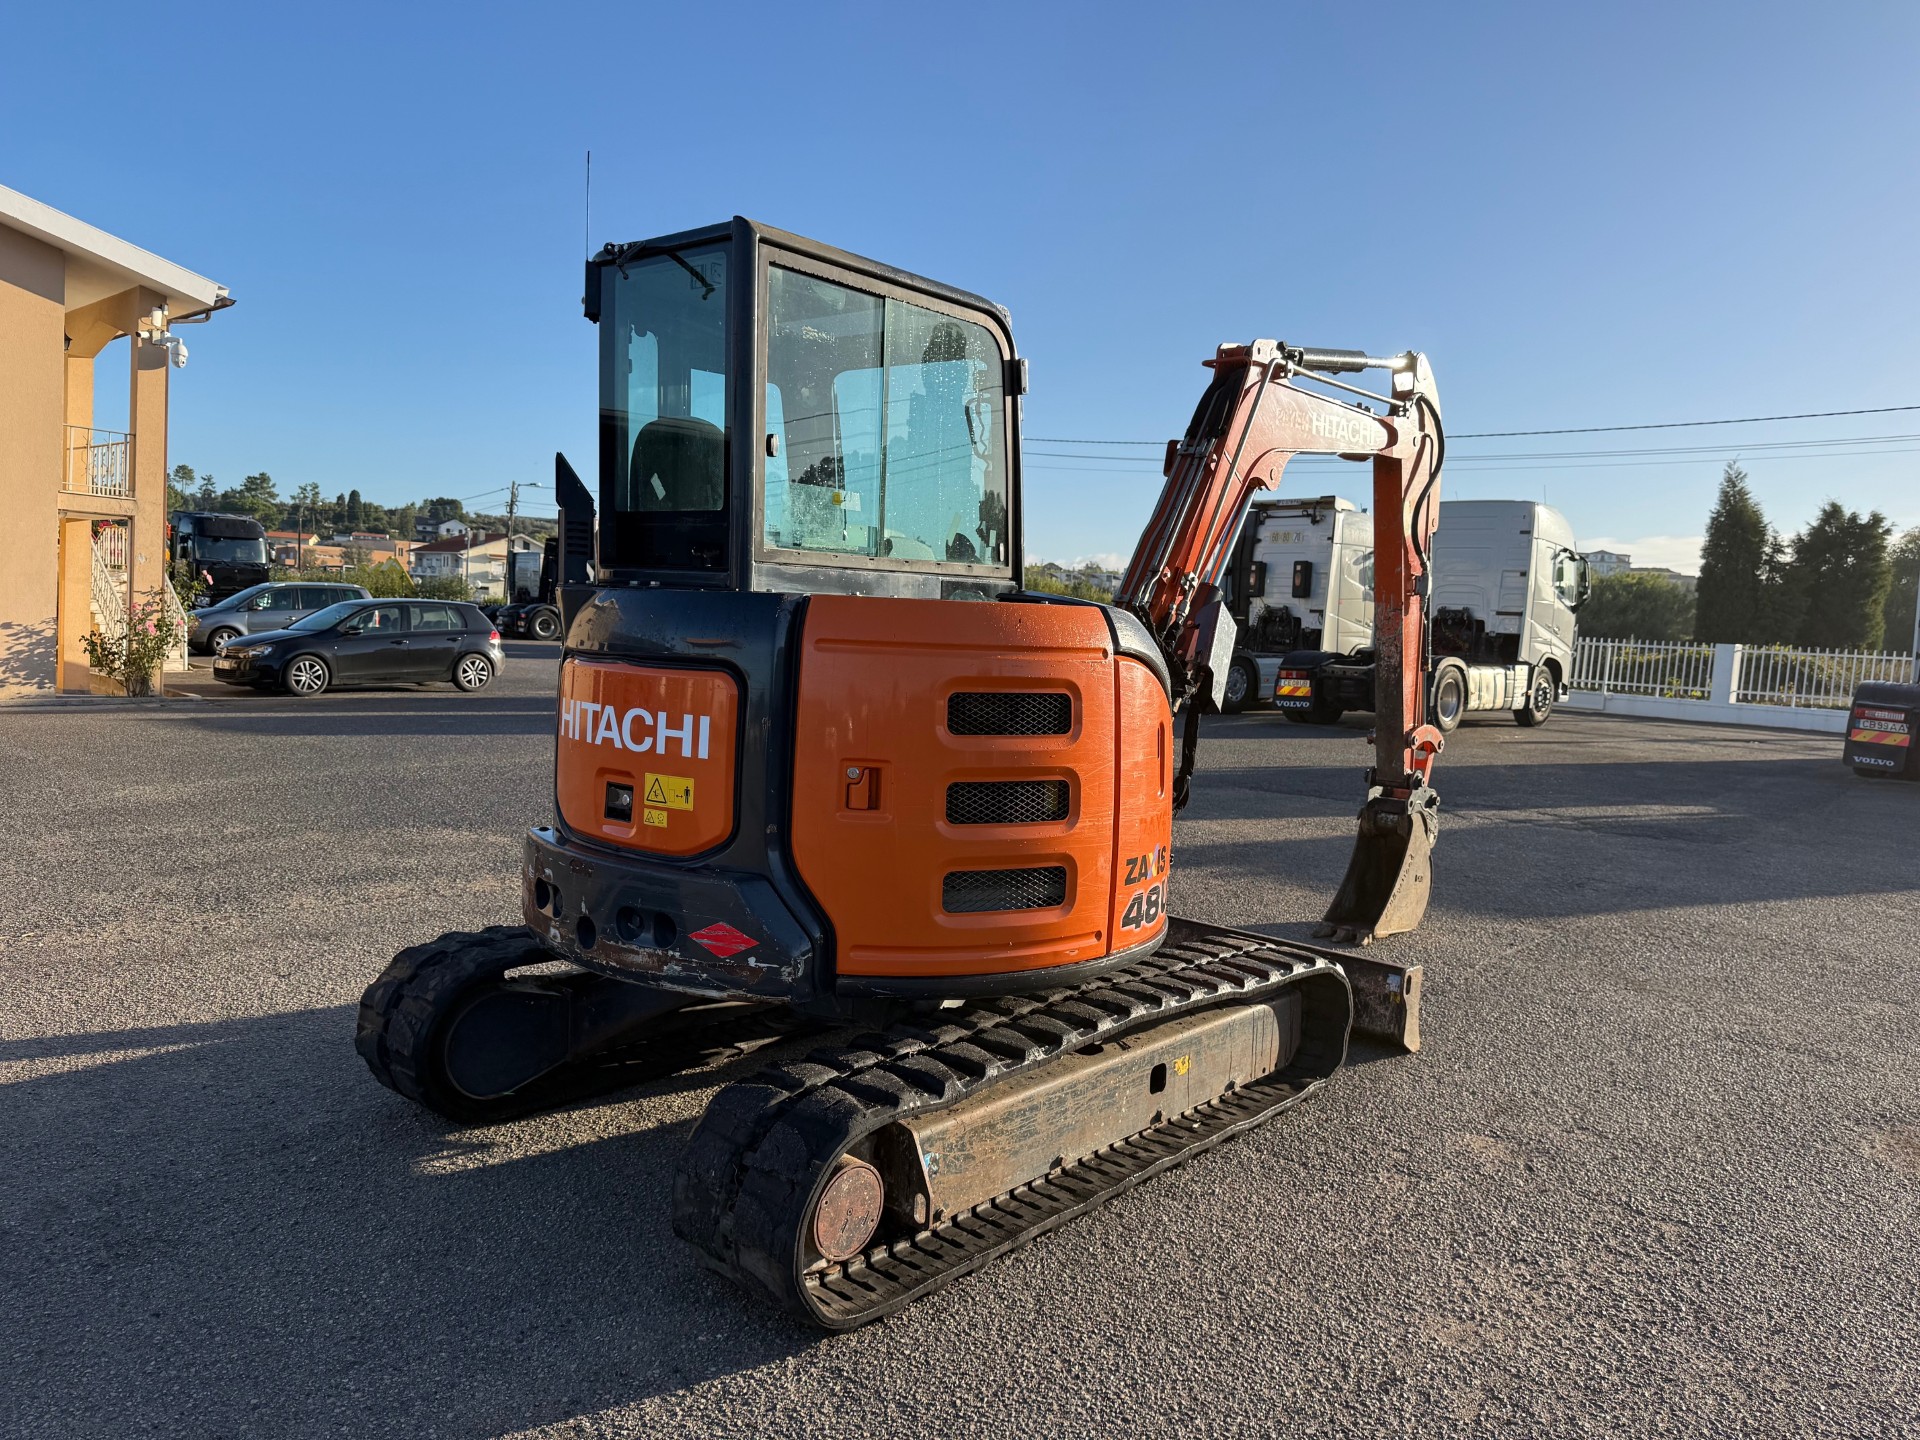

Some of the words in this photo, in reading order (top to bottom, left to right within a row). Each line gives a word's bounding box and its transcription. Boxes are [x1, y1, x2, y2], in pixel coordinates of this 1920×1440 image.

[1312, 412, 1376, 446] HITACHI
[1276, 700, 1310, 708] VOLVO
[560, 697, 711, 760] HITACHI
[1852, 755, 1895, 767] VOLVO
[1124, 843, 1167, 887] ZAXIS
